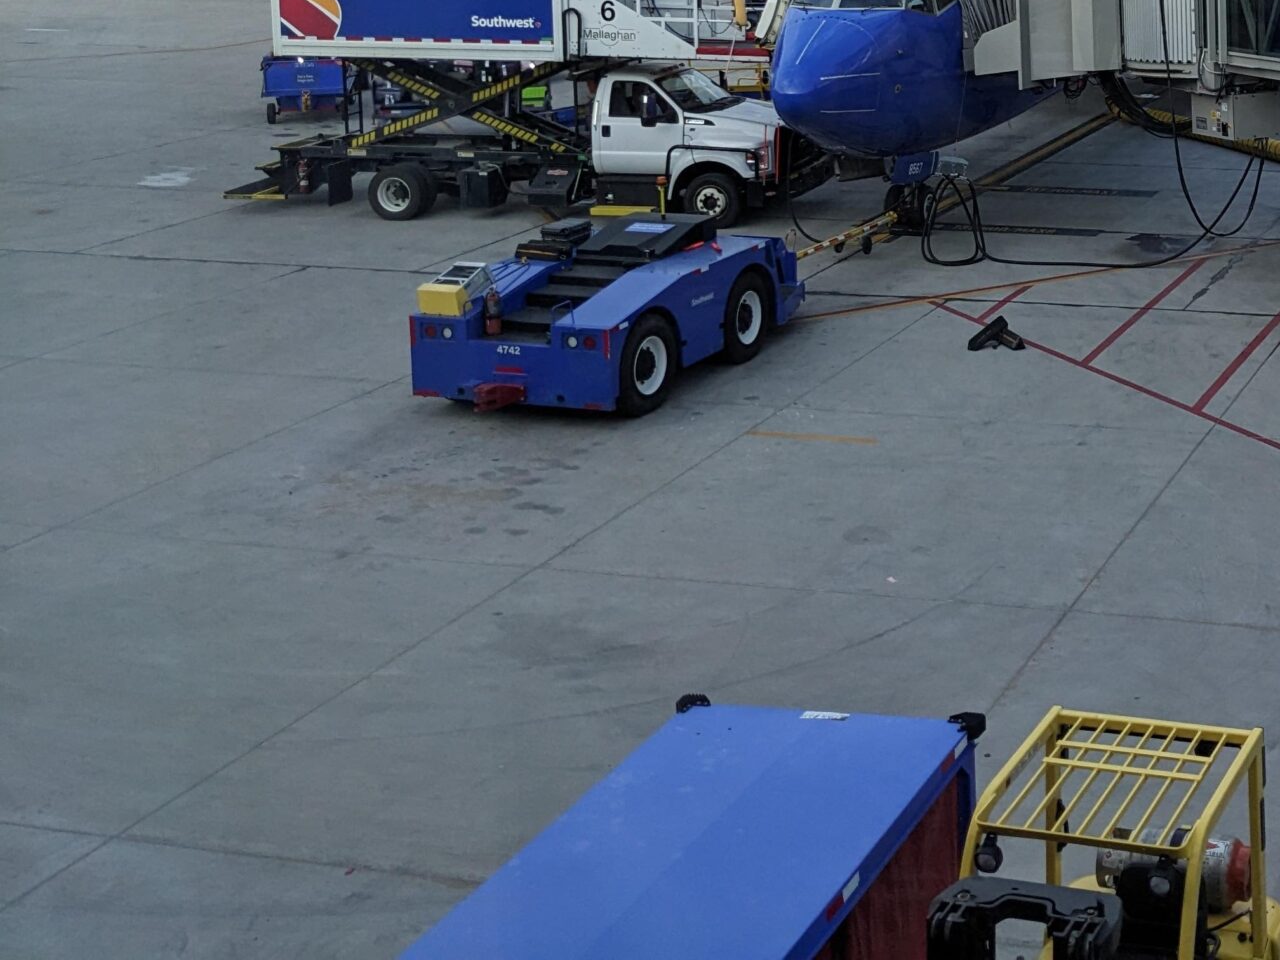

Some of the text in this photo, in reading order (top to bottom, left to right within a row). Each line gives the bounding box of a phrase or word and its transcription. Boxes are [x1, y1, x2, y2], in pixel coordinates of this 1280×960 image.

[601, 0, 615, 21] 6
[471, 15, 534, 28] Southwest
[583, 29, 637, 41] Mallaghan
[497, 345, 521, 356] 4742
